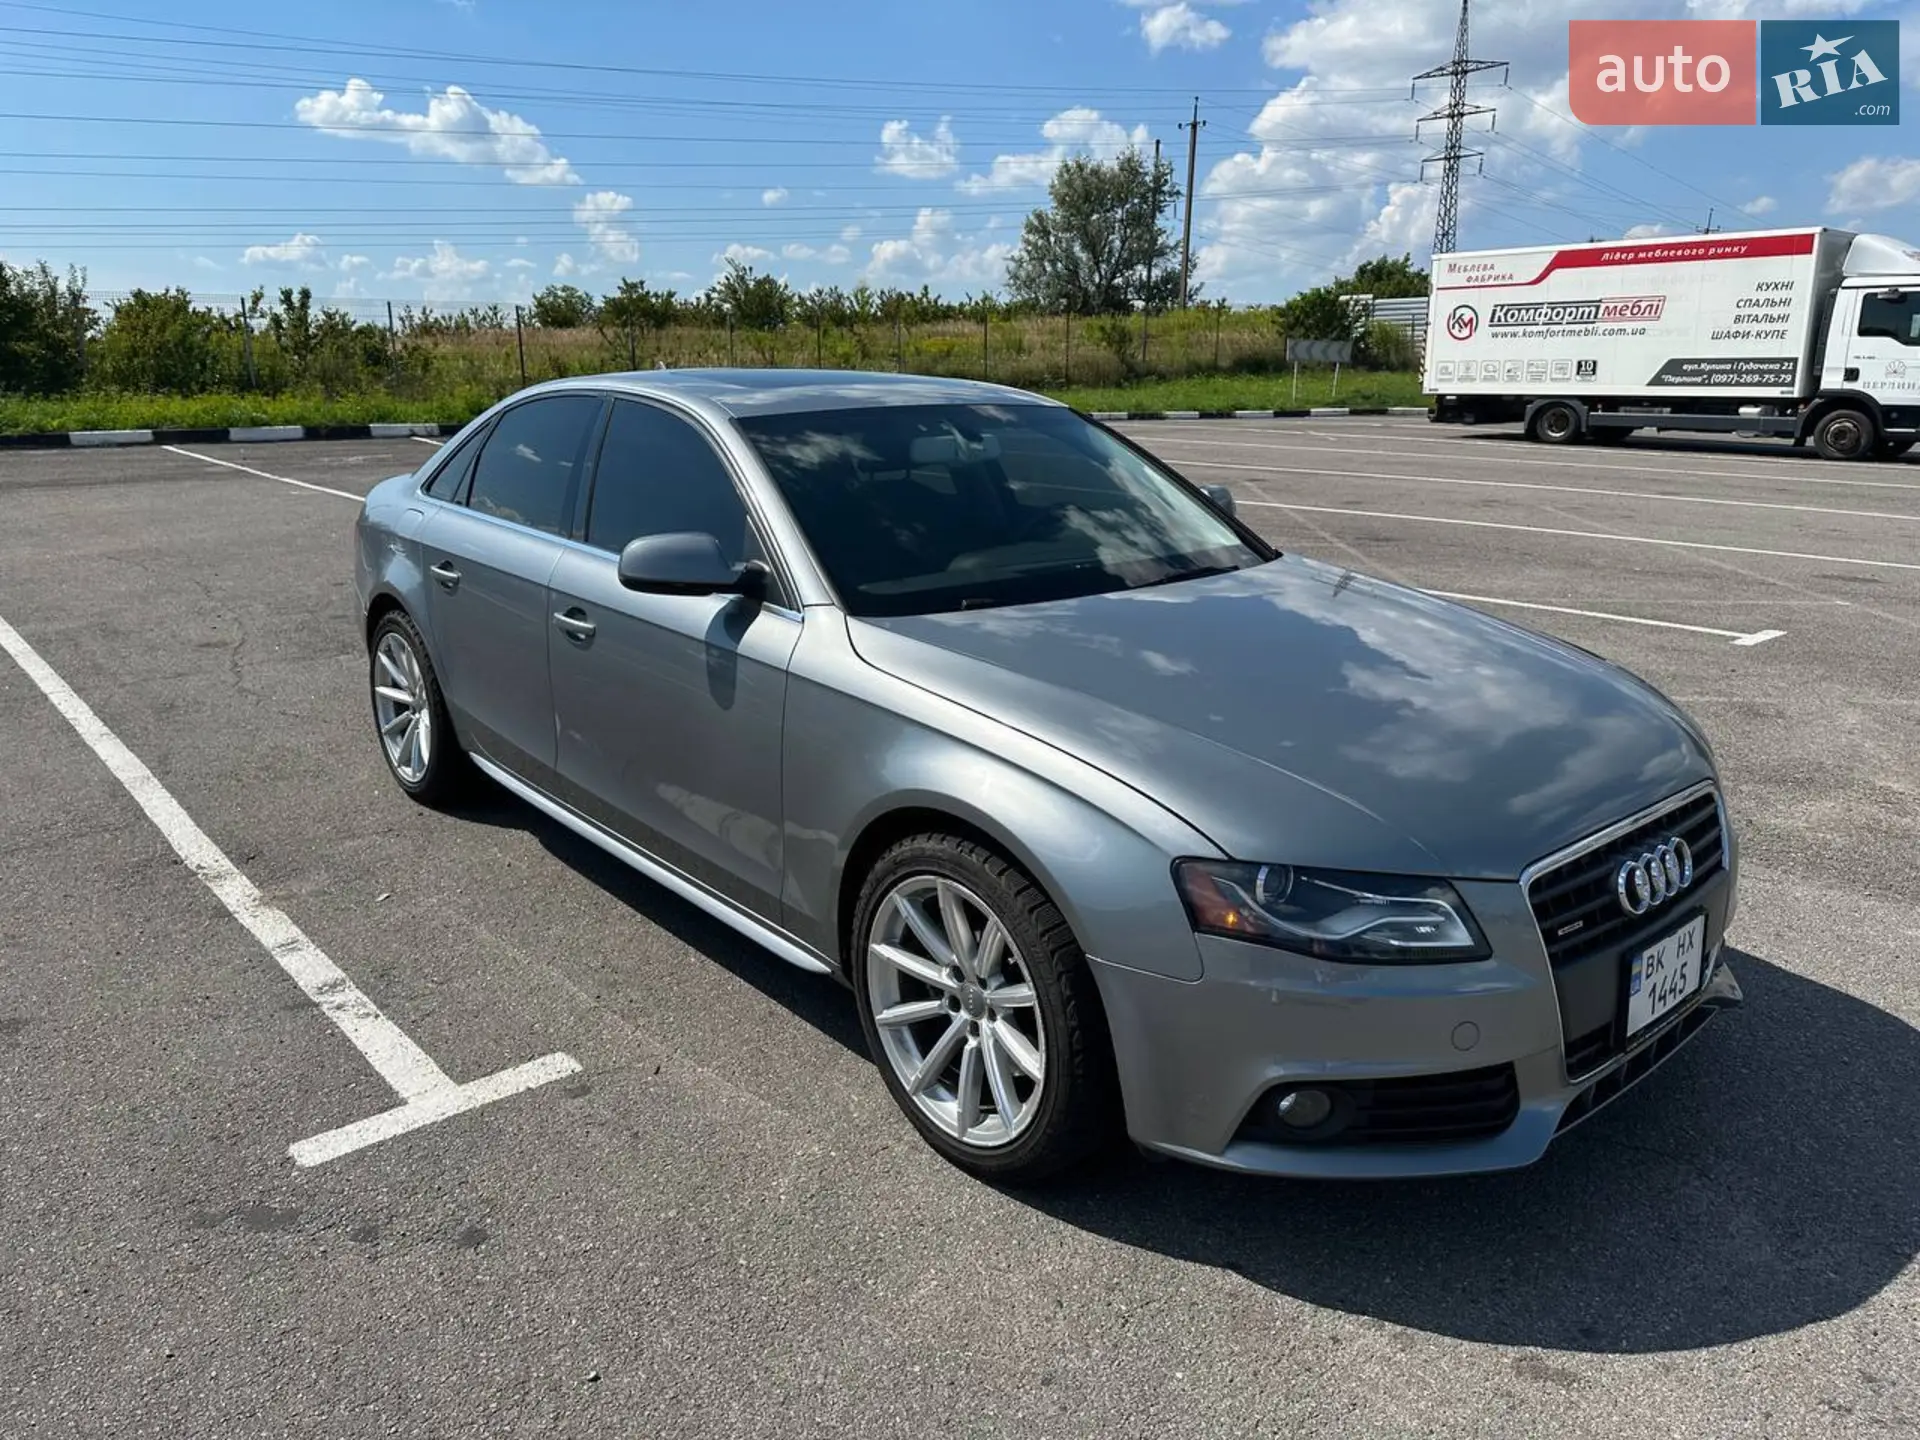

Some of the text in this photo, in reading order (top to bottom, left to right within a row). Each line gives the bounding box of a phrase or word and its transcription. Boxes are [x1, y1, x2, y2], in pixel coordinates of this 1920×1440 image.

[1755, 281, 1795, 292] КУХНІ
[1736, 298, 1792, 309] СПАЛЬНІ
[1733, 314, 1789, 325] ВІТАЛЬНІ
[1491, 327, 1646, 339] www.komfortmebli.com.ua
[1711, 330, 1788, 341] ШАФИ-КУПЕ
[1580, 361, 1593, 371] 10
[1782, 361, 1794, 370] 21
[1648, 960, 1688, 1015] 1445
